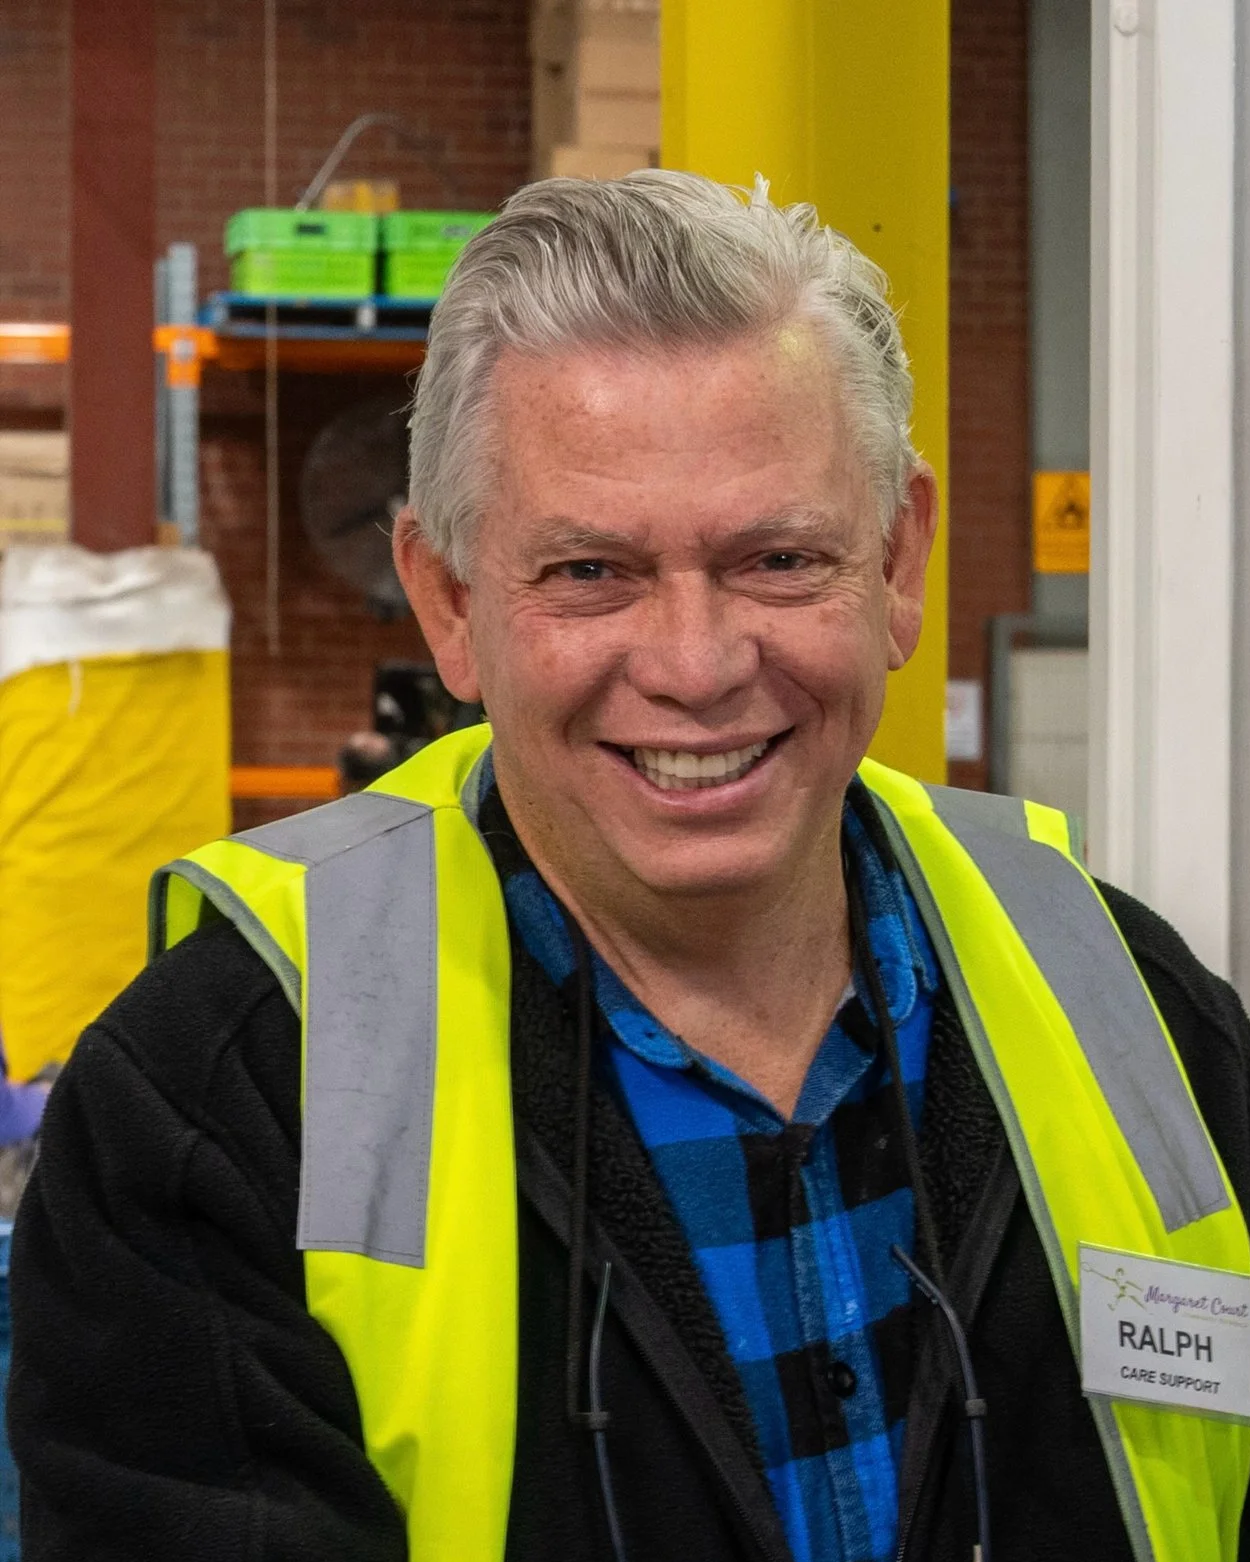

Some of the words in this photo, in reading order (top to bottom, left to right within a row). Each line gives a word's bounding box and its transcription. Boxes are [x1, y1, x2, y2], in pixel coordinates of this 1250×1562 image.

[1144, 1285, 1208, 1314] Margaret
[1118, 1320, 1213, 1363] RALPH
[1120, 1365, 1157, 1384] CARE
[1158, 1372, 1221, 1395] SUPPORT
